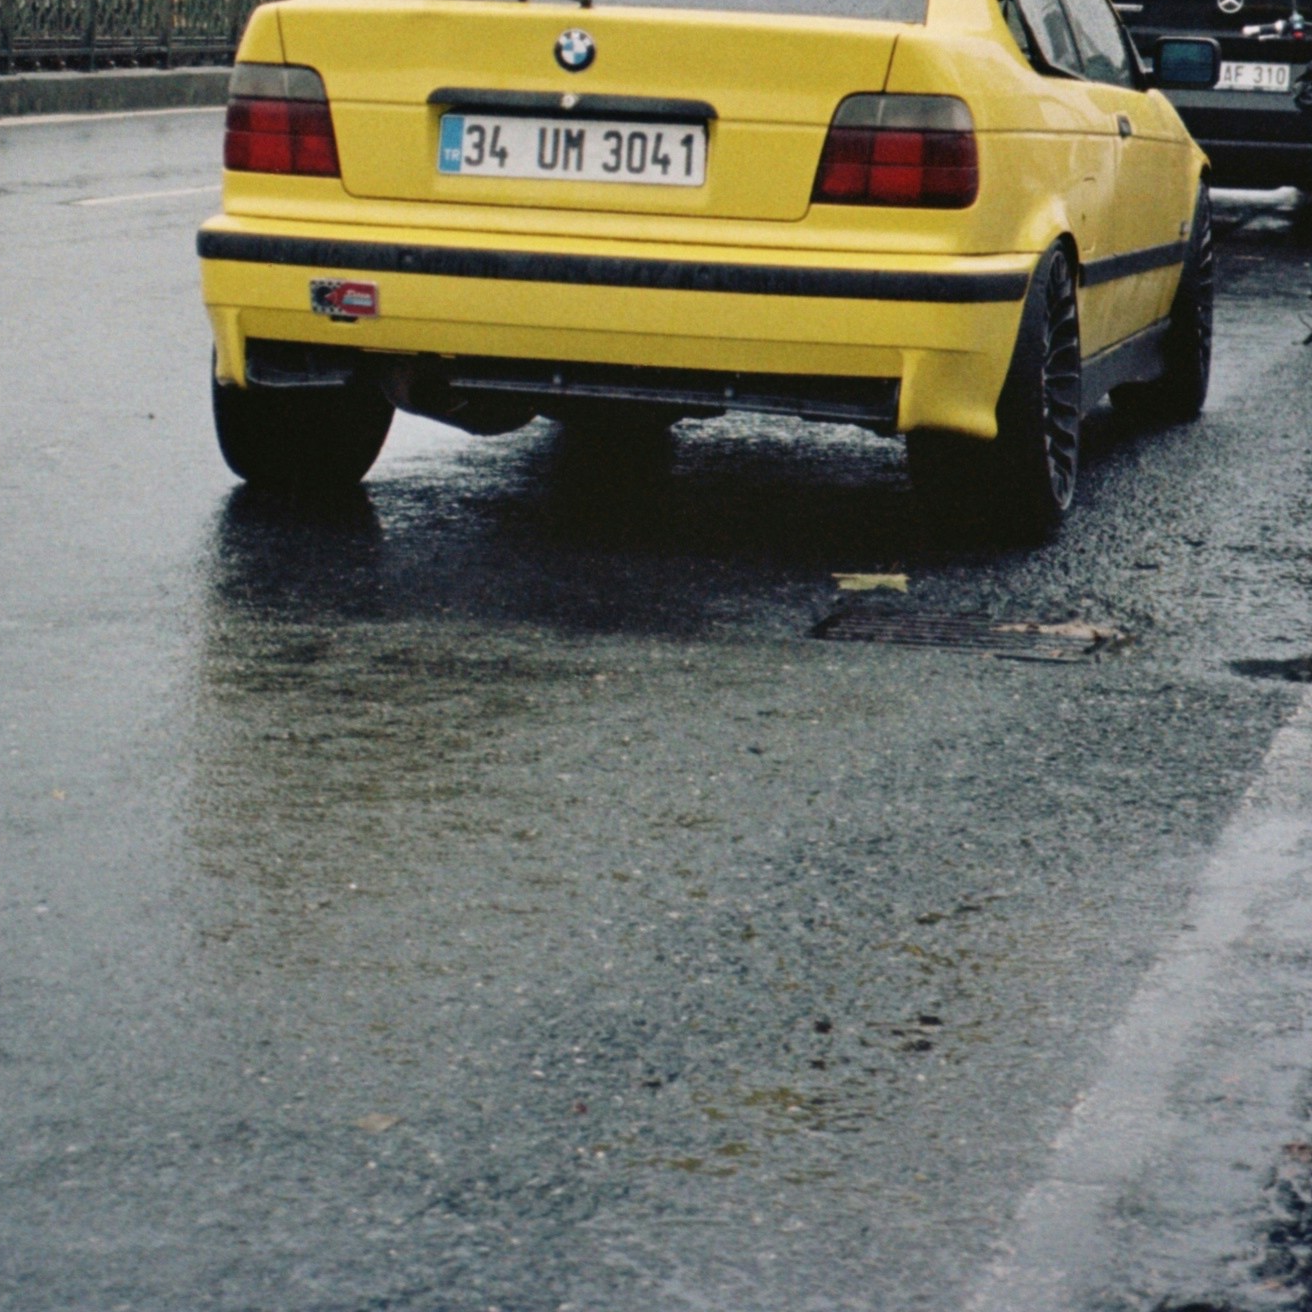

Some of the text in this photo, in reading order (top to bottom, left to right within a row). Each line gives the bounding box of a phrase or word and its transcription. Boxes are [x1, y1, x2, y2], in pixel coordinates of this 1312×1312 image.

[1223, 65, 1286, 85] AF 310
[444, 124, 694, 176] TR 34 UM 3041
